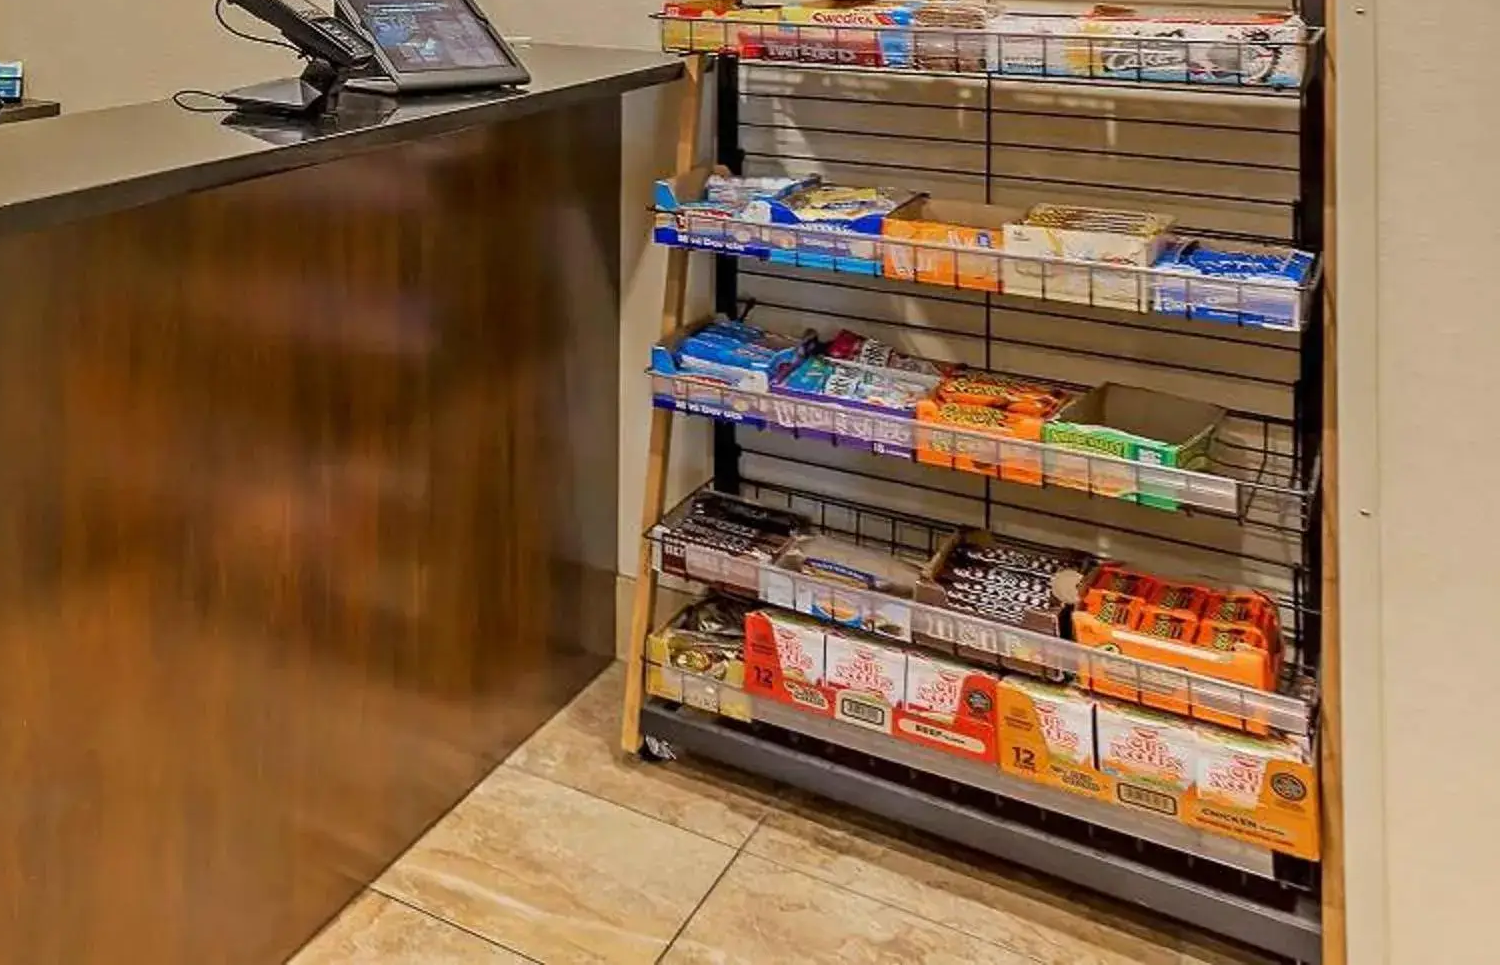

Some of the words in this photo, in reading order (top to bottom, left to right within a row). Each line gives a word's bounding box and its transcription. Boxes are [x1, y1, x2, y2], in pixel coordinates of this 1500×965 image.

[754, 666, 773, 684] 12
[1012, 746, 1035, 765] 12
[1200, 808, 1256, 828] CHICKEN
